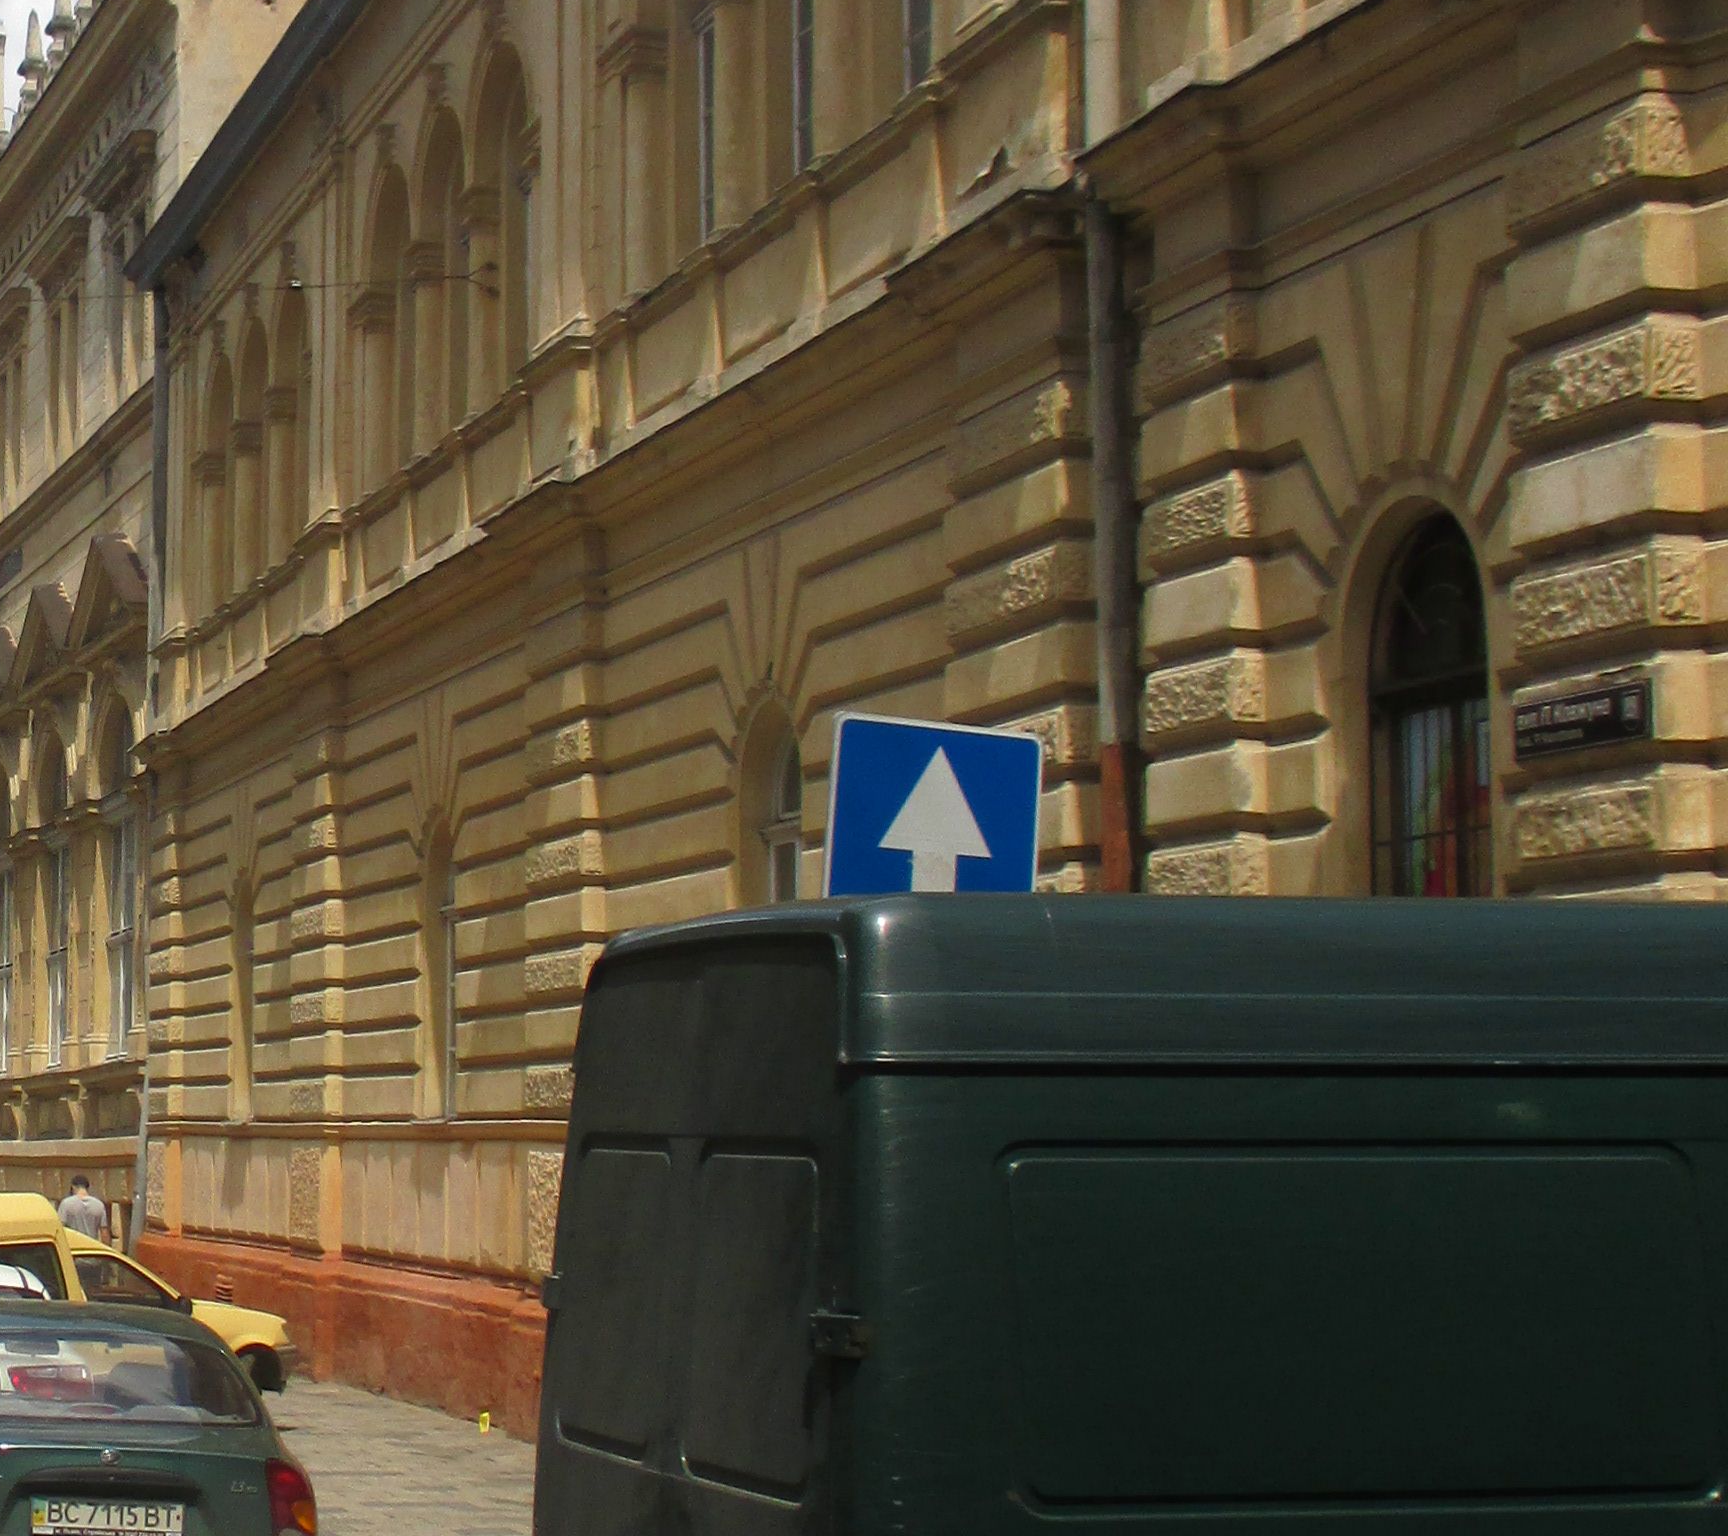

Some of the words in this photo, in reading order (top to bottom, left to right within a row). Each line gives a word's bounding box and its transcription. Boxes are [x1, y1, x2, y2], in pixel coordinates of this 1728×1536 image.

[47, 1499, 79, 1524] BC
[87, 1502, 138, 1527] 7115
[144, 1505, 177, 1529] BT
